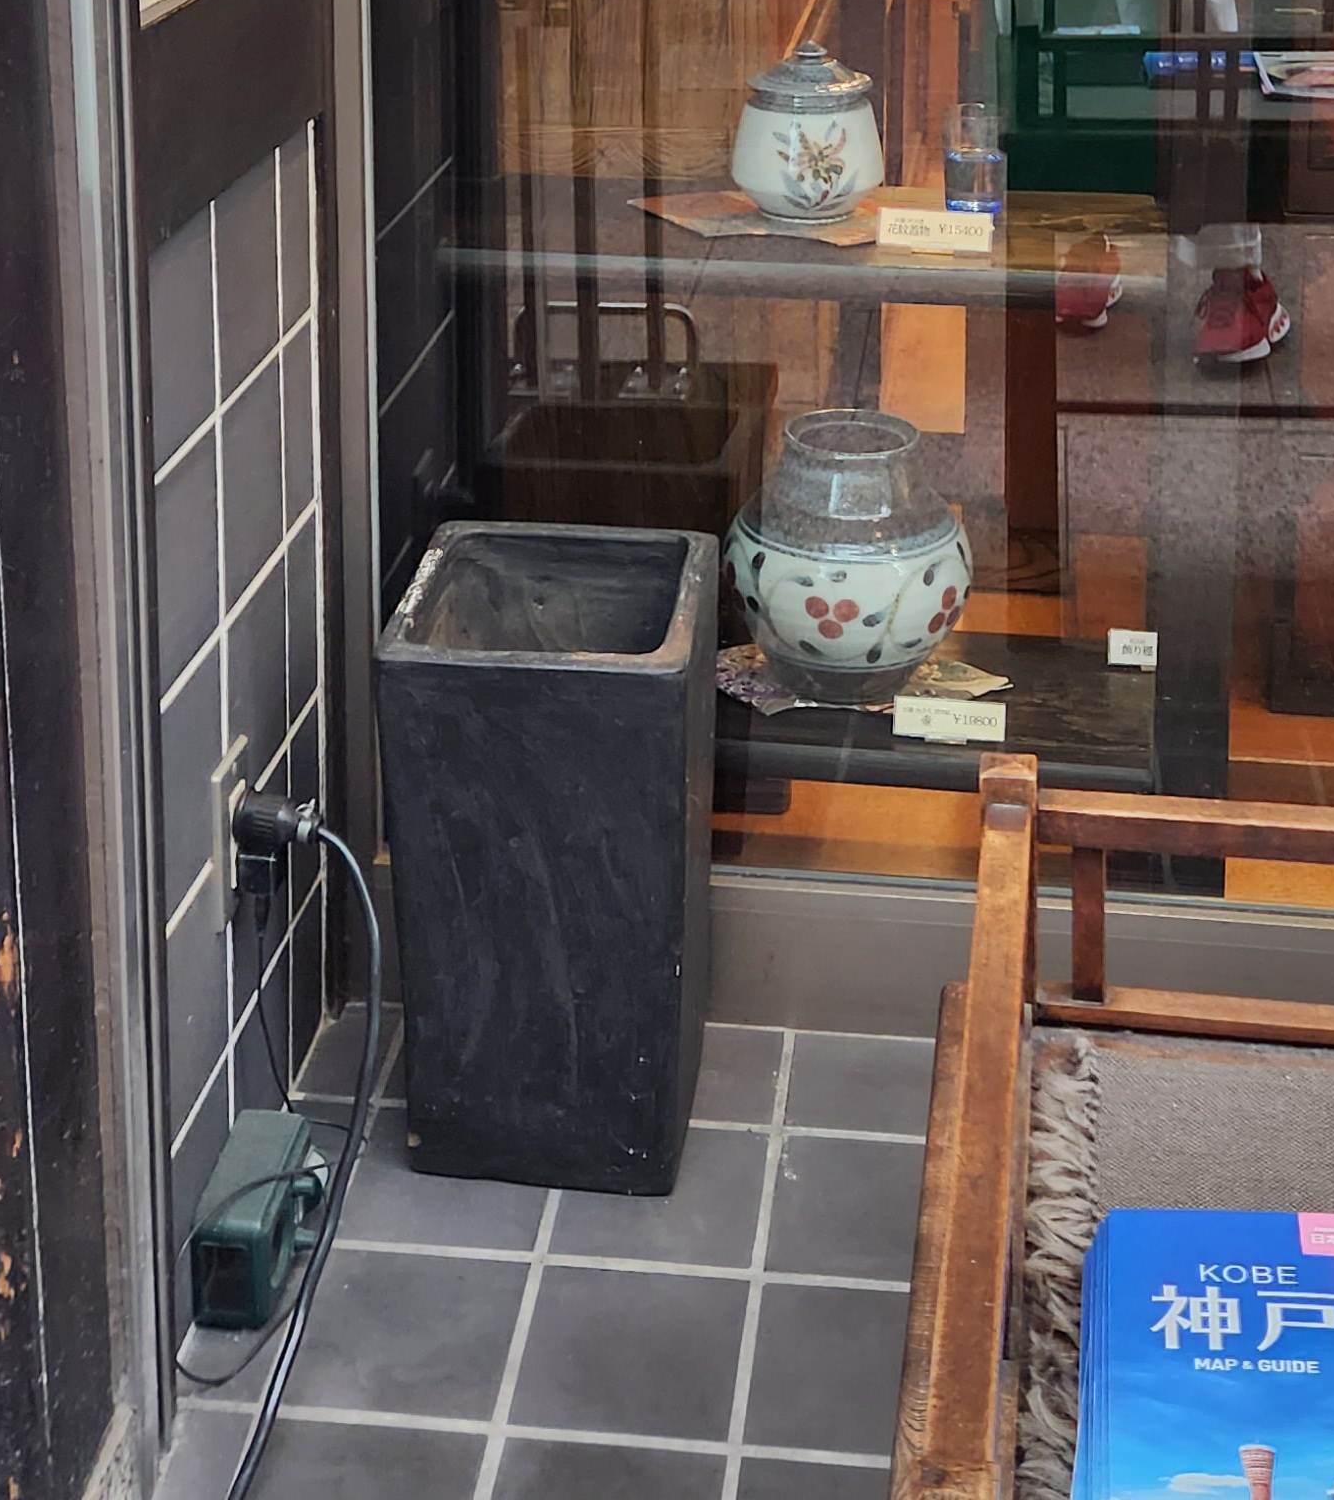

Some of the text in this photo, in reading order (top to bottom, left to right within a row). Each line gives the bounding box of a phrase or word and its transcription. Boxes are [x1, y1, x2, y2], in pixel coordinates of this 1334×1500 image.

[1197, 1263, 1298, 1286] KOBE
[1194, 1357, 1321, 1374] MAP & GUIDE
